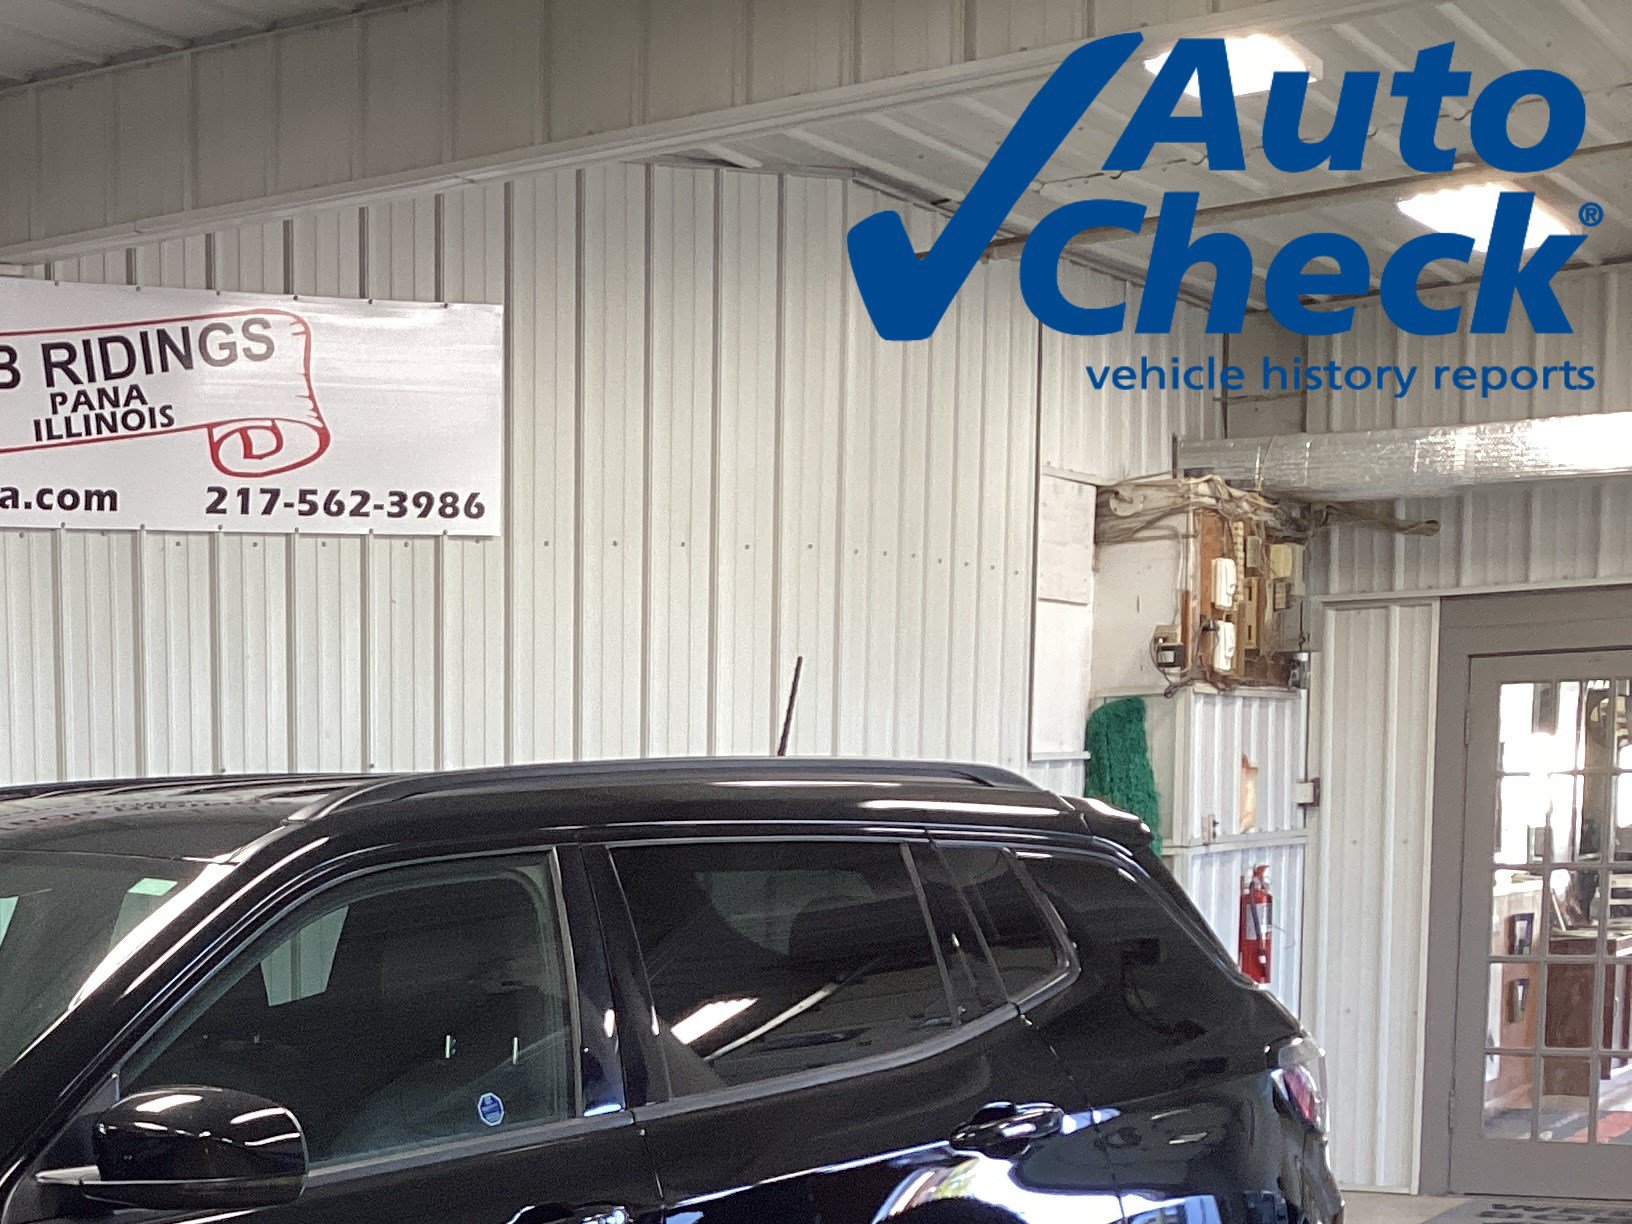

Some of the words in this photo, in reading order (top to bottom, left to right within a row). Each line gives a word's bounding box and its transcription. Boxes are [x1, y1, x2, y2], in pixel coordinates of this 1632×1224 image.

[40, 317, 275, 388] RIDINGS
[49, 384, 148, 415] PANA
[33, 404, 175, 442] ILLINOIS
[206, 486, 486, 520] 217-562-3986
